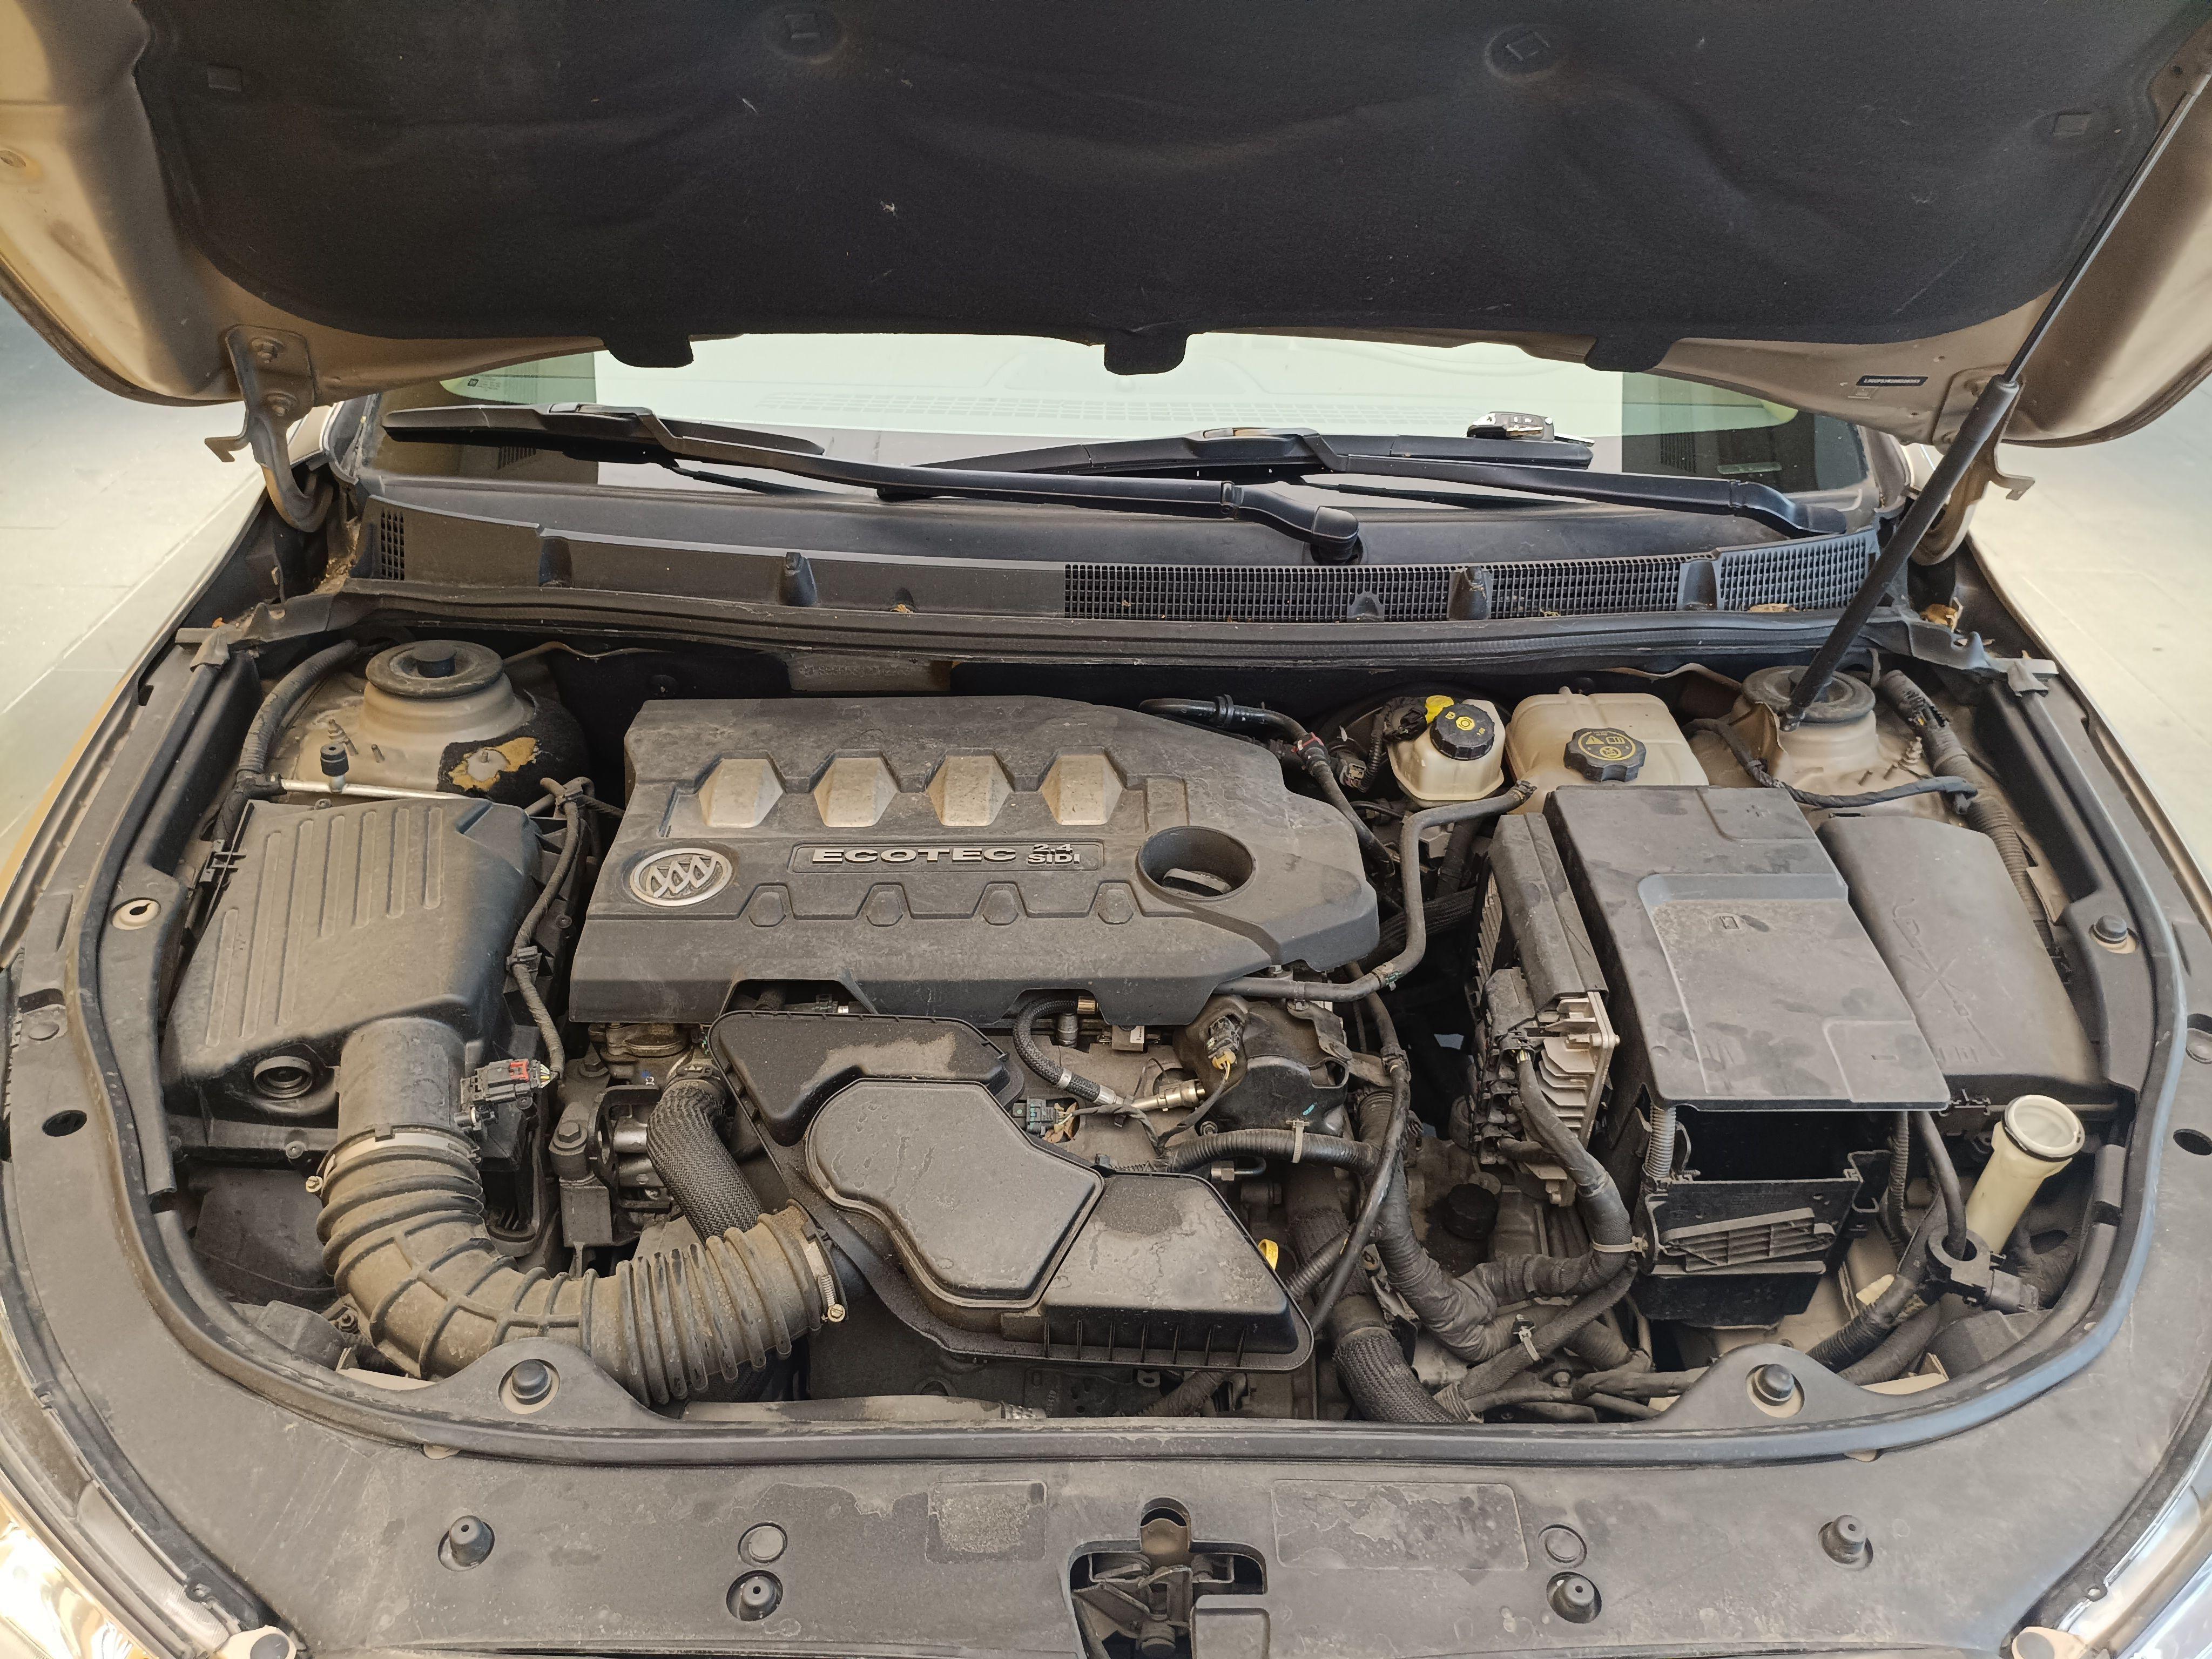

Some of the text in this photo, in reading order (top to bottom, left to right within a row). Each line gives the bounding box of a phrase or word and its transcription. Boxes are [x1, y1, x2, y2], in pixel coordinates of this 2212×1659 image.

[1033, 844, 1073, 855] 2.4
[812, 847, 1016, 864] ECOTEC
[1028, 853, 1080, 864] SIDI
